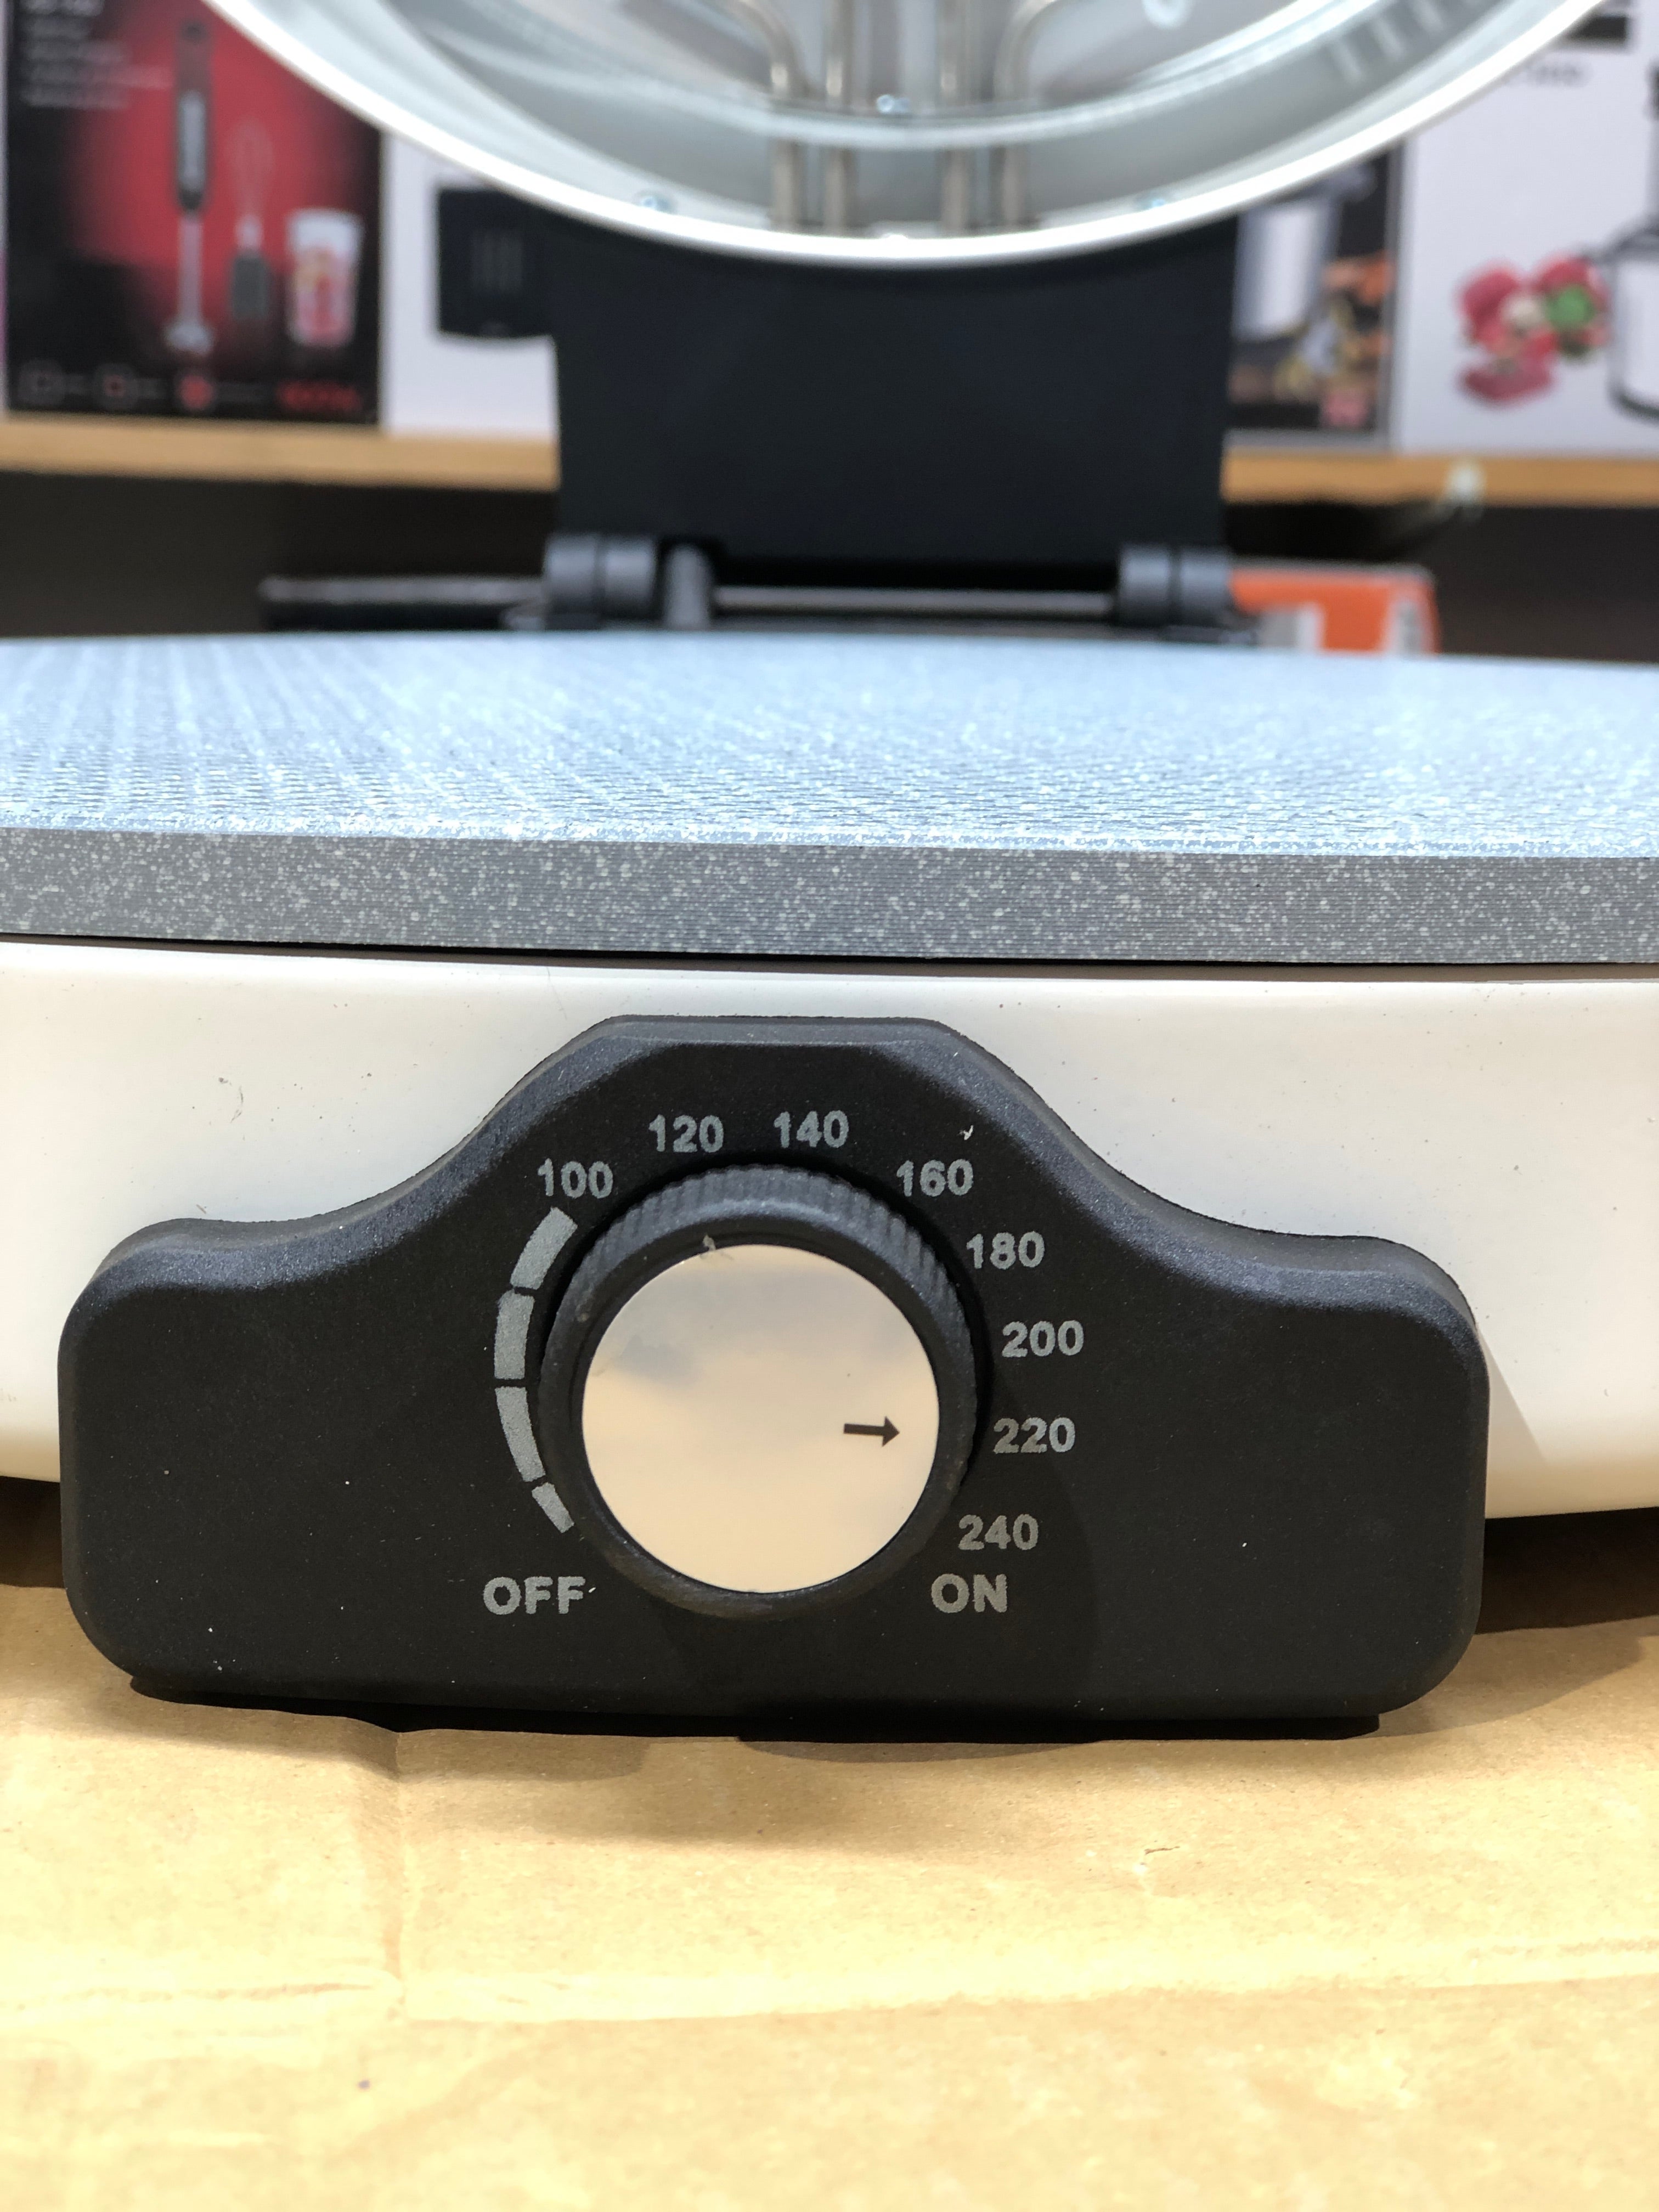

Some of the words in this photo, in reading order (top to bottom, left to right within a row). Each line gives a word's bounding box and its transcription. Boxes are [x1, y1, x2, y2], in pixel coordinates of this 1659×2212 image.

[649, 1115, 723, 1152] 120
[774, 1110, 849, 1148] 140
[538, 1159, 613, 1198] 100
[897, 1159, 973, 1197] 160
[967, 1231, 1045, 1269] 180
[1002, 1321, 1084, 1357] 200
[994, 1418, 1075, 1453] 220
[959, 1514, 1038, 1550] 240
[483, 1576, 585, 1614] OFF
[932, 1574, 1007, 1613] ON
